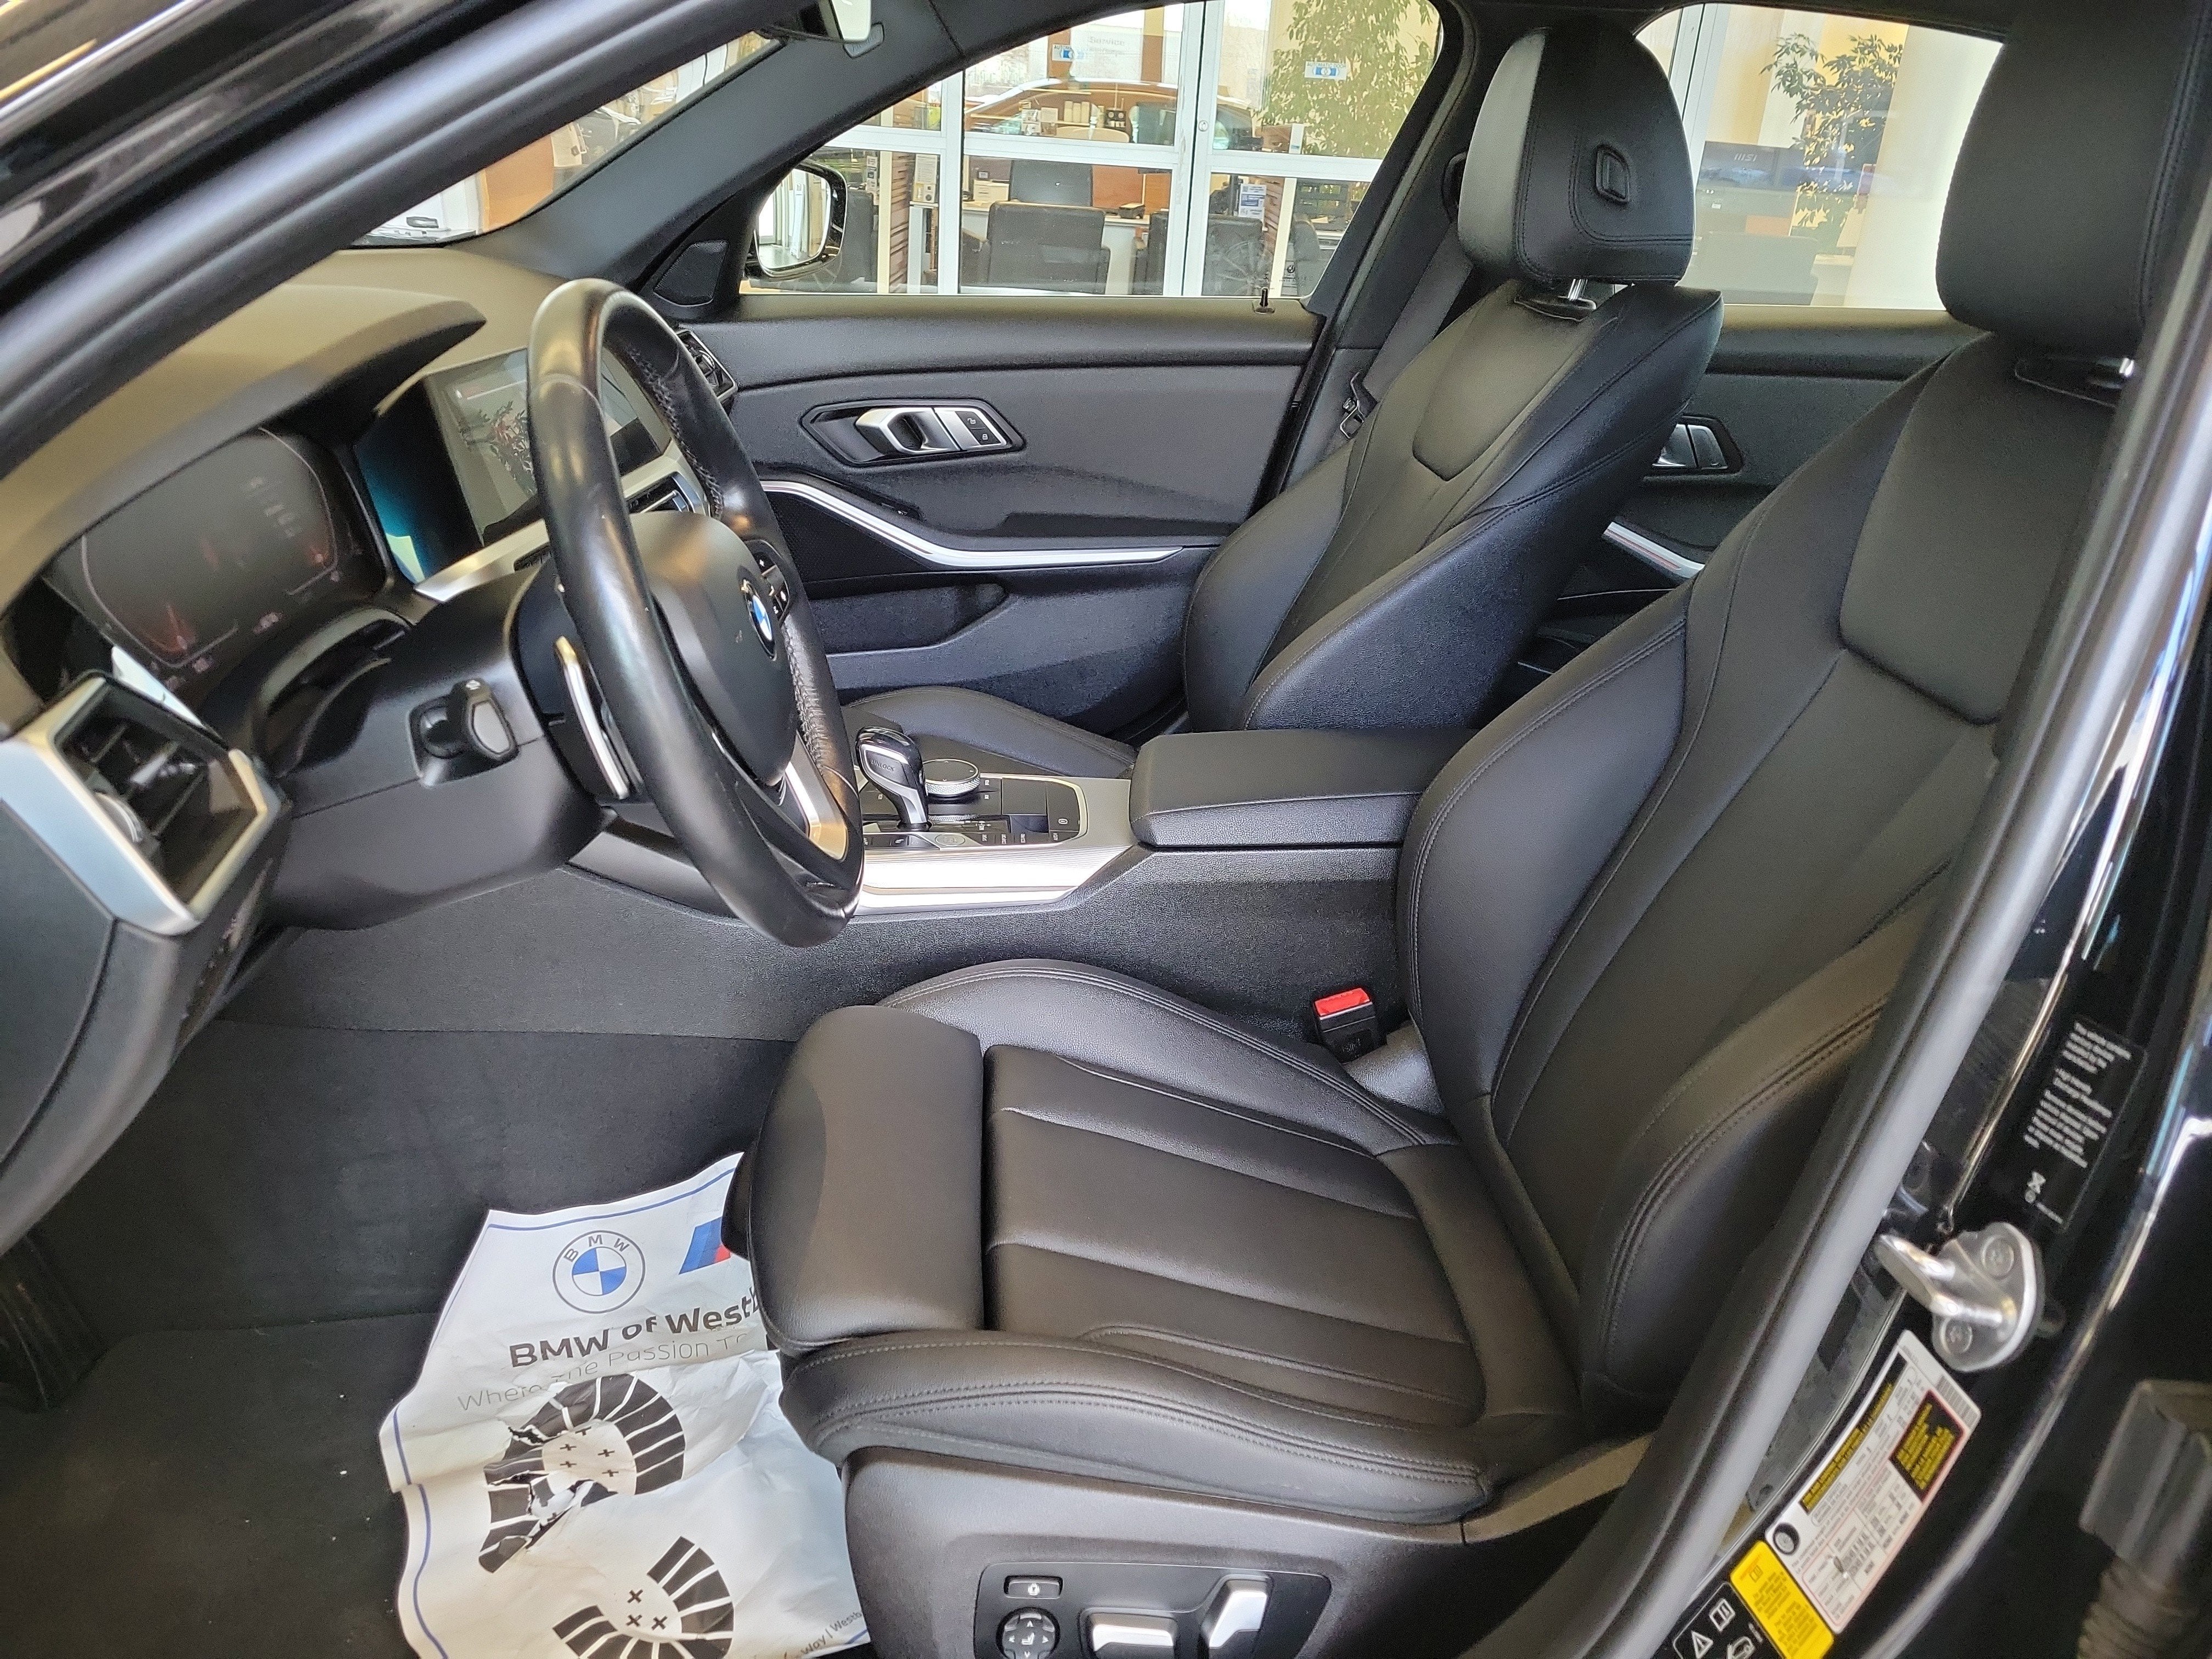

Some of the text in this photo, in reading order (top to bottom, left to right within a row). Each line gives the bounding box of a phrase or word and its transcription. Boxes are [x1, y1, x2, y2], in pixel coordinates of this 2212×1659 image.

[871, 759, 895, 772] UNLOCK
[563, 1234, 630, 1263] BMW
[509, 1328, 609, 1368] BMW
[621, 1316, 658, 1340] of
[608, 1340, 709, 1367] Passion
